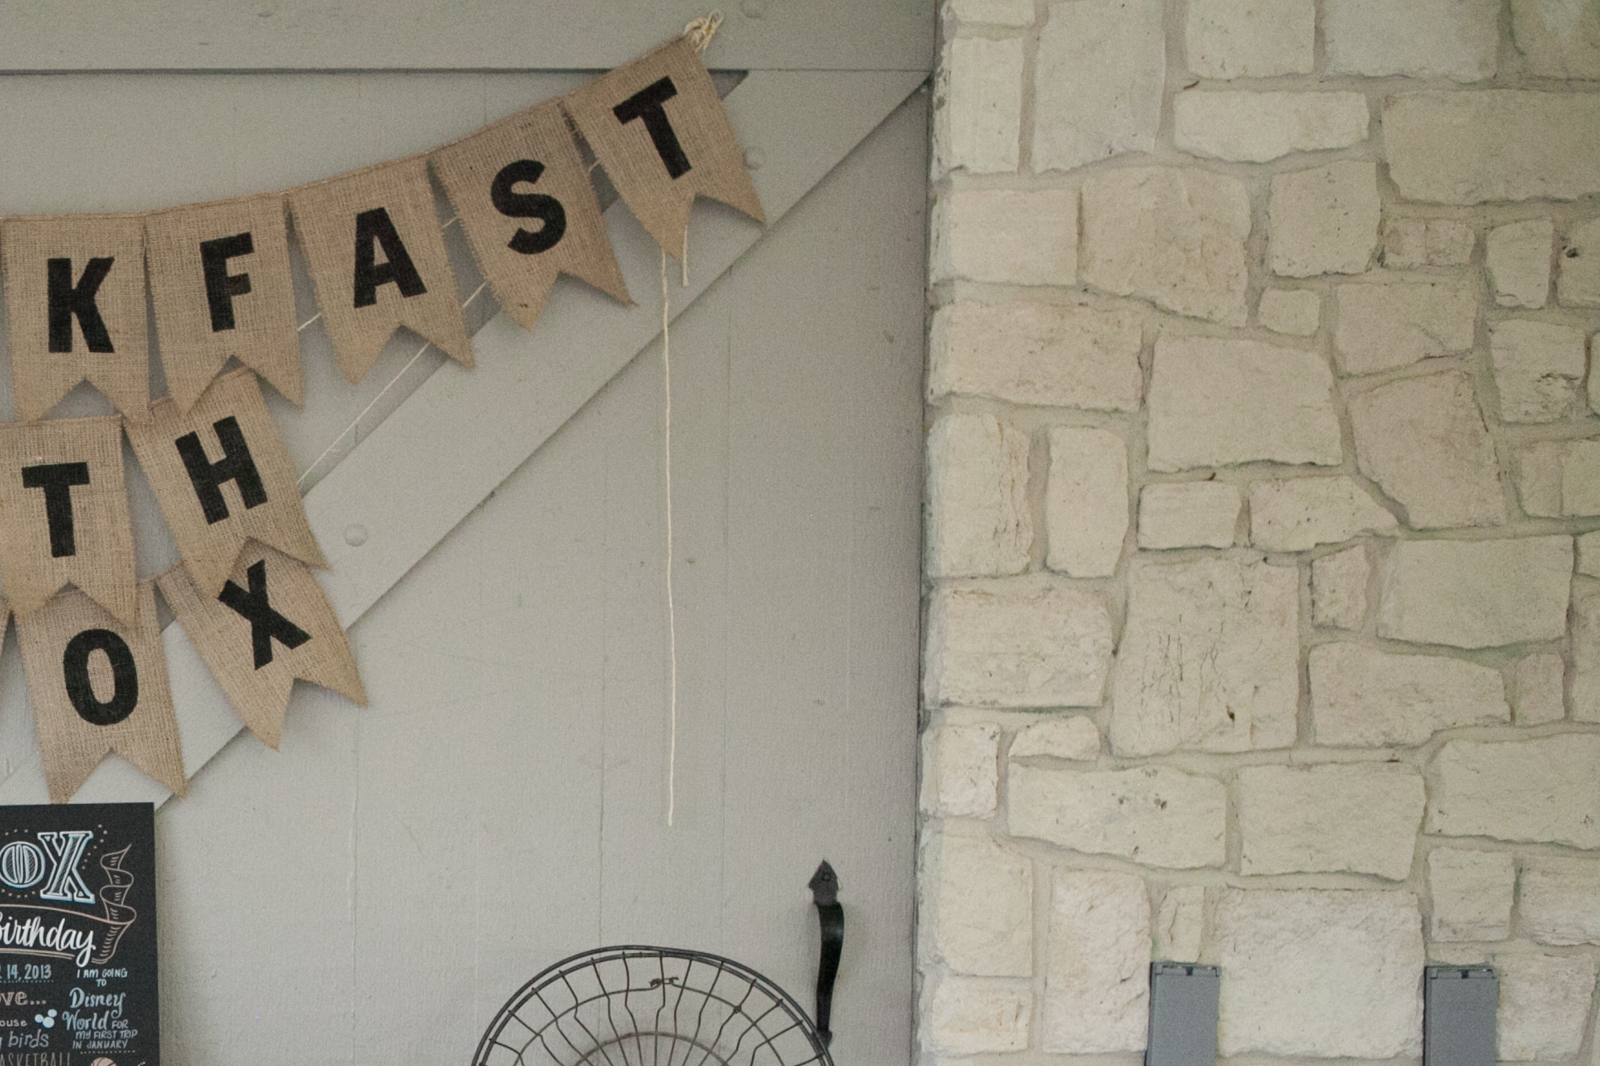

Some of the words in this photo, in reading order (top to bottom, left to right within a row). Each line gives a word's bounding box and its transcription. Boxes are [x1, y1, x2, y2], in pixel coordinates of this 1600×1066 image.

[77, 969, 81, 979] I
[102, 968, 128, 978] GOING
[96, 979, 107, 987] TO
[69, 987, 126, 1019] Disney
[62, 1009, 110, 1031] World
[111, 1019, 129, 1029] FOR
[8, 1029, 49, 1048] birds
[94, 1030, 118, 1039] FIRST
[119, 1029, 138, 1039] TRIP
[72, 1040, 82, 1049] IN
[86, 1039, 129, 1049] JANUARY
